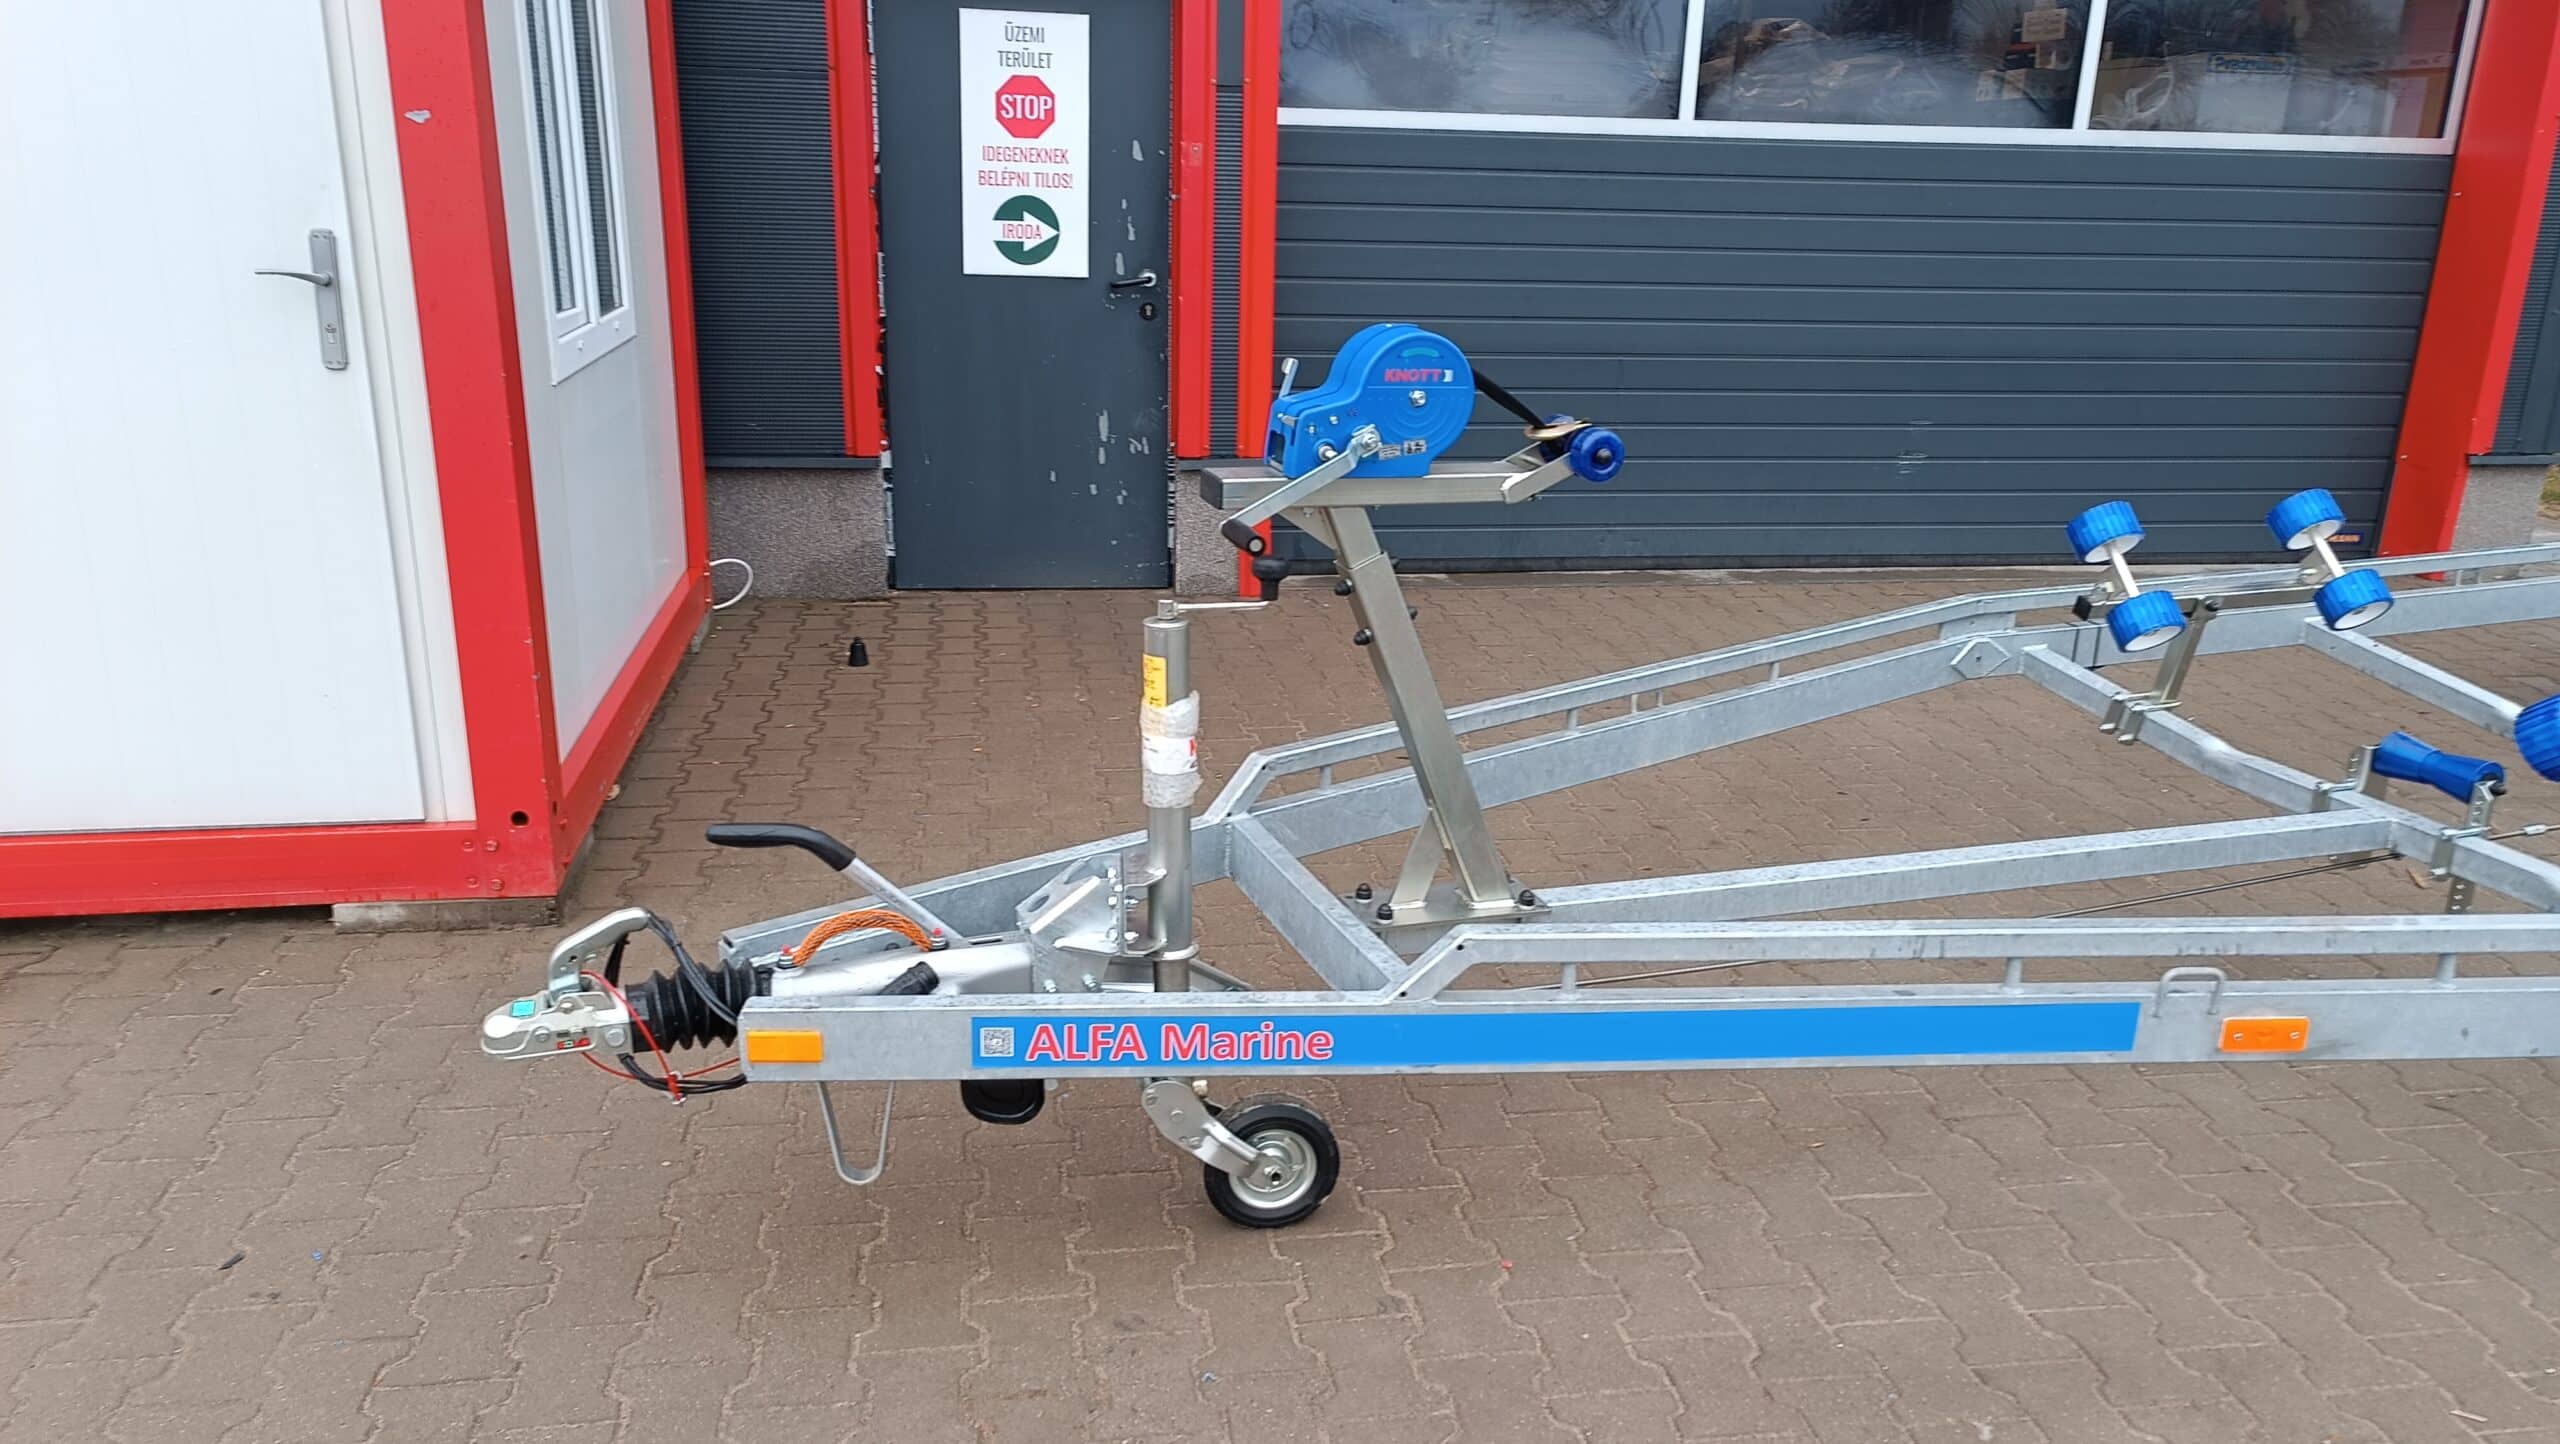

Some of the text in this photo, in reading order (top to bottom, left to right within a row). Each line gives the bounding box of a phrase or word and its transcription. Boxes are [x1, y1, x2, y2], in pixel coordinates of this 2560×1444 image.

[1004, 20, 1045, 43] ÜZEMI
[997, 47, 1053, 69] TERÜLET
[1000, 94, 1053, 121] STOP
[982, 145, 1069, 165] IDEGENEKNEK
[978, 166, 1073, 189] BELÉPNI TILOS!
[1002, 223, 1042, 240] IRODA
[1384, 368, 1442, 383] KNOTT
[1026, 1021, 1334, 1062] ALFA Marine
